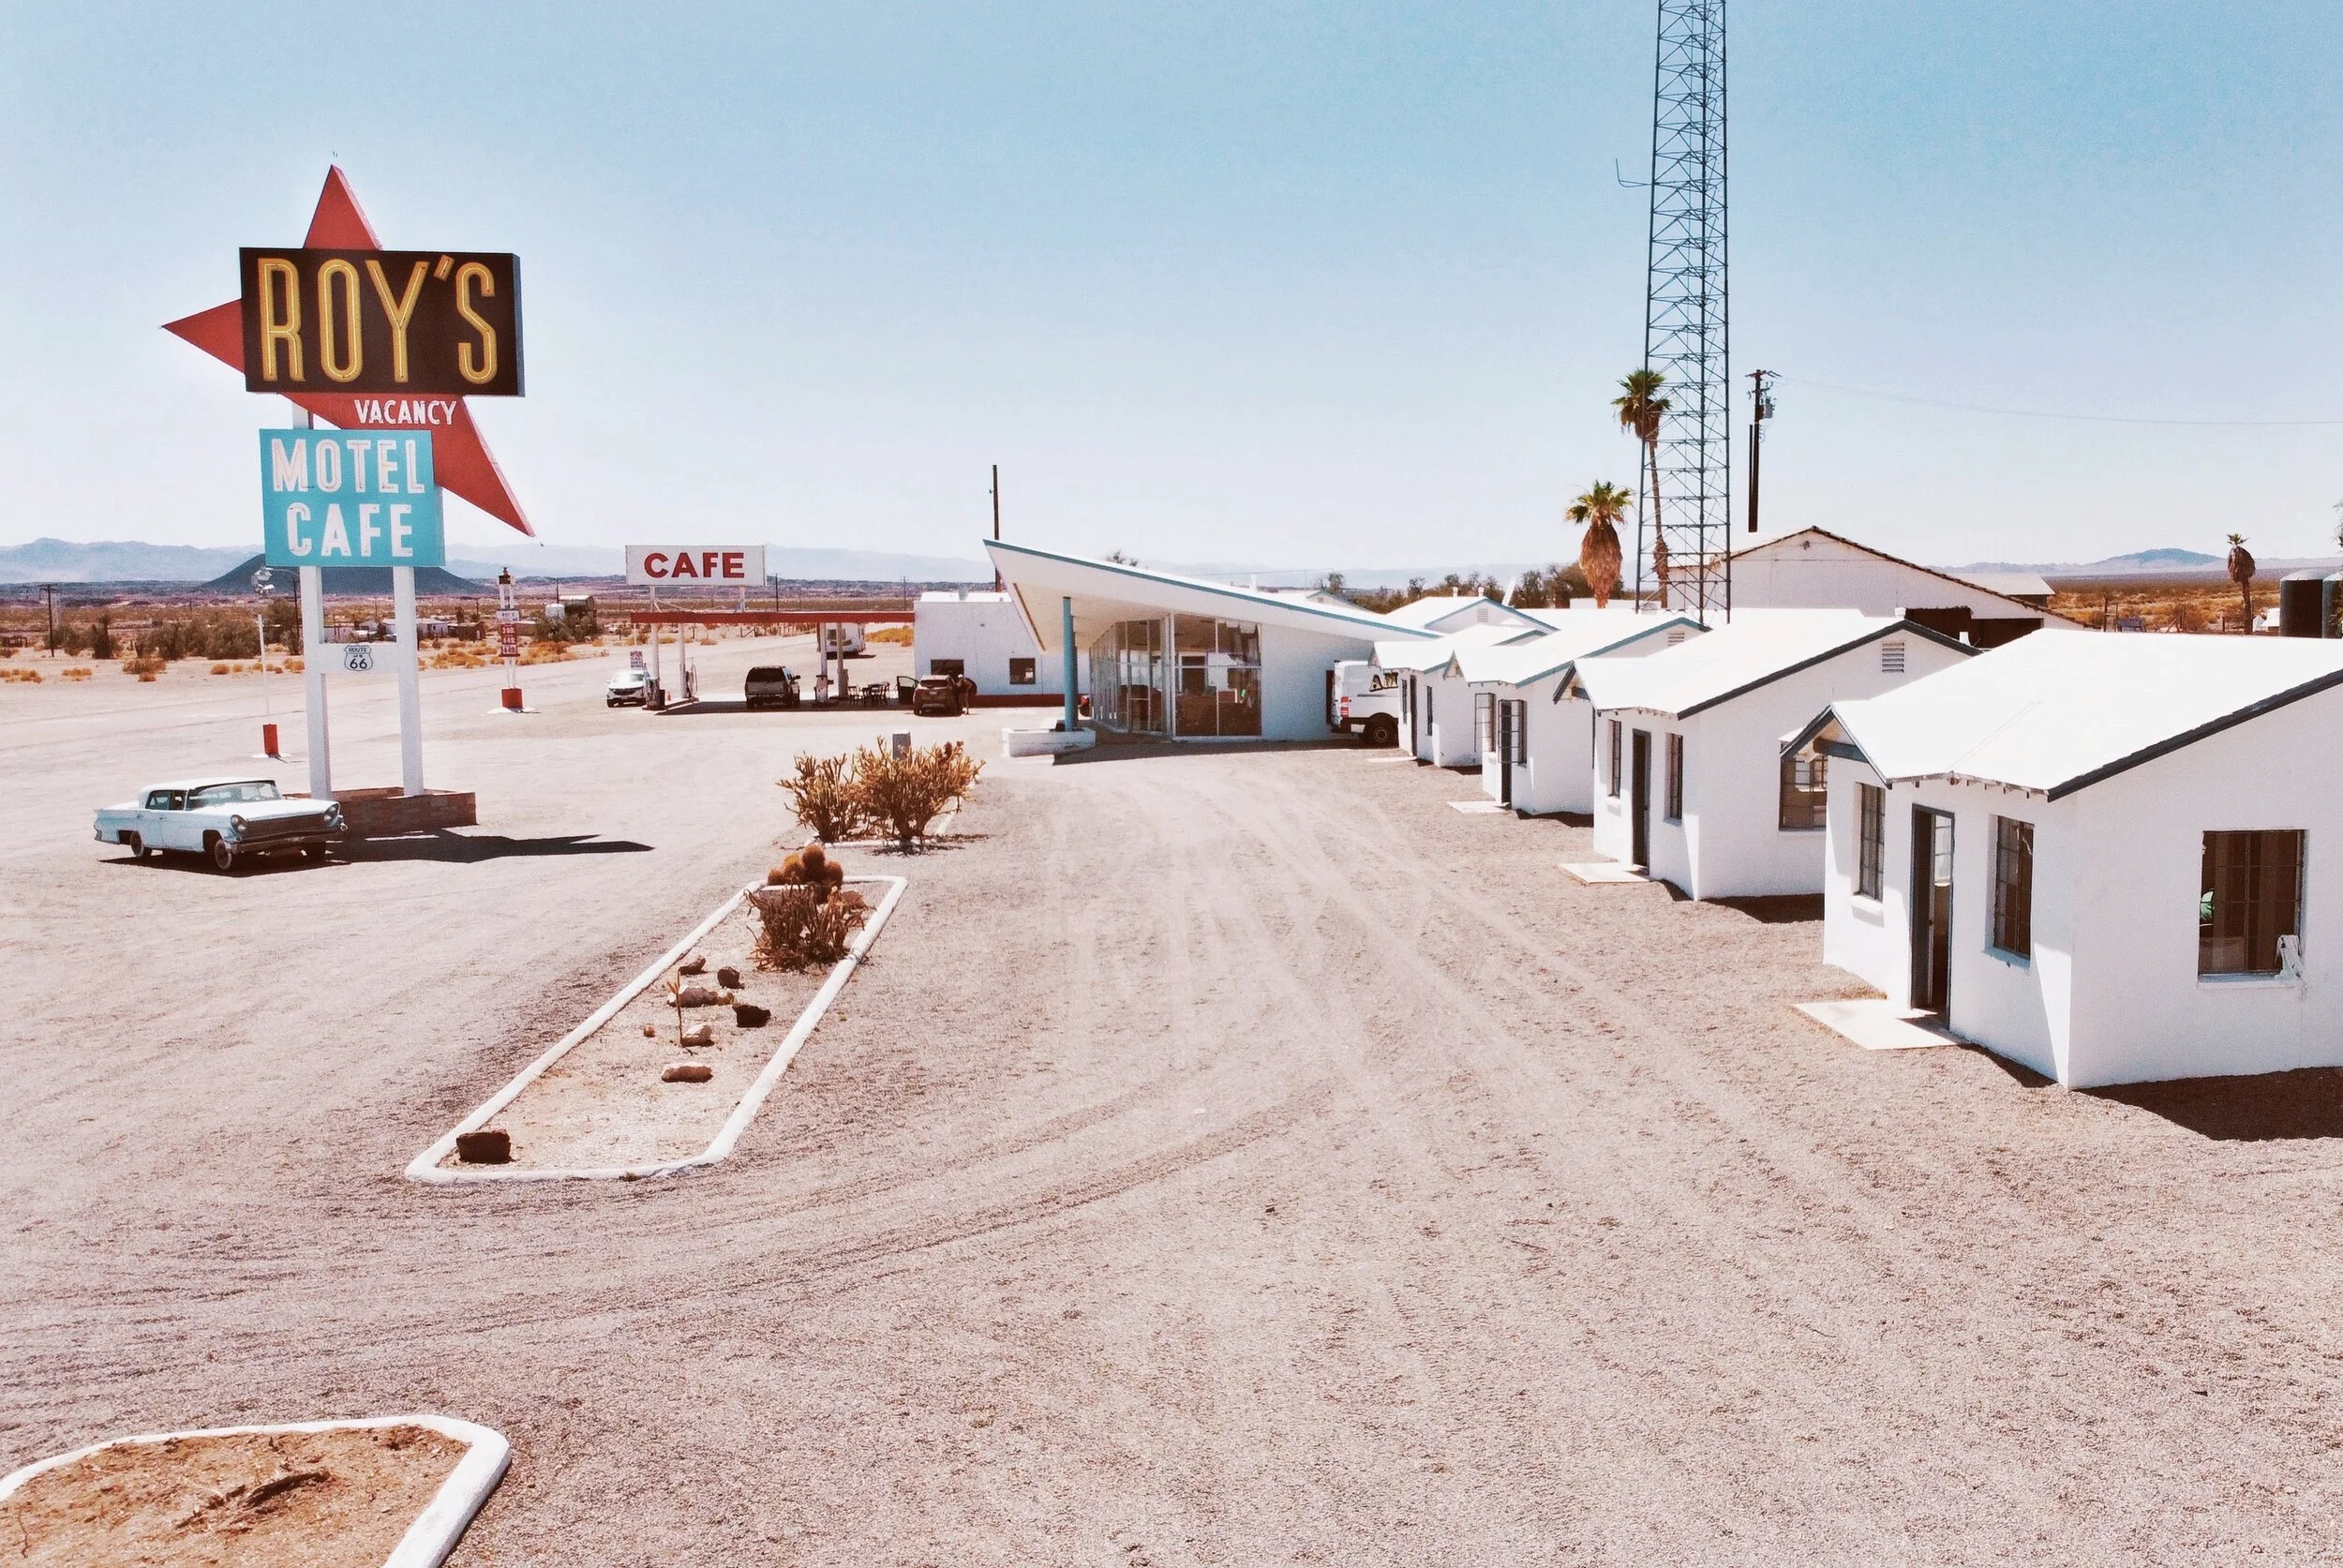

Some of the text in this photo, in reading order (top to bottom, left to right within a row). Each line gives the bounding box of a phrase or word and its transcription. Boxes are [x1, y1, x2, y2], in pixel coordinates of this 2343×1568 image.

[257, 255, 498, 382] ROY'S
[354, 399, 457, 426] VACANCY
[271, 438, 425, 495] MOTEL
[287, 501, 414, 558] CAFE
[644, 552, 745, 579] CAFE
[350, 659, 367, 669] 66
